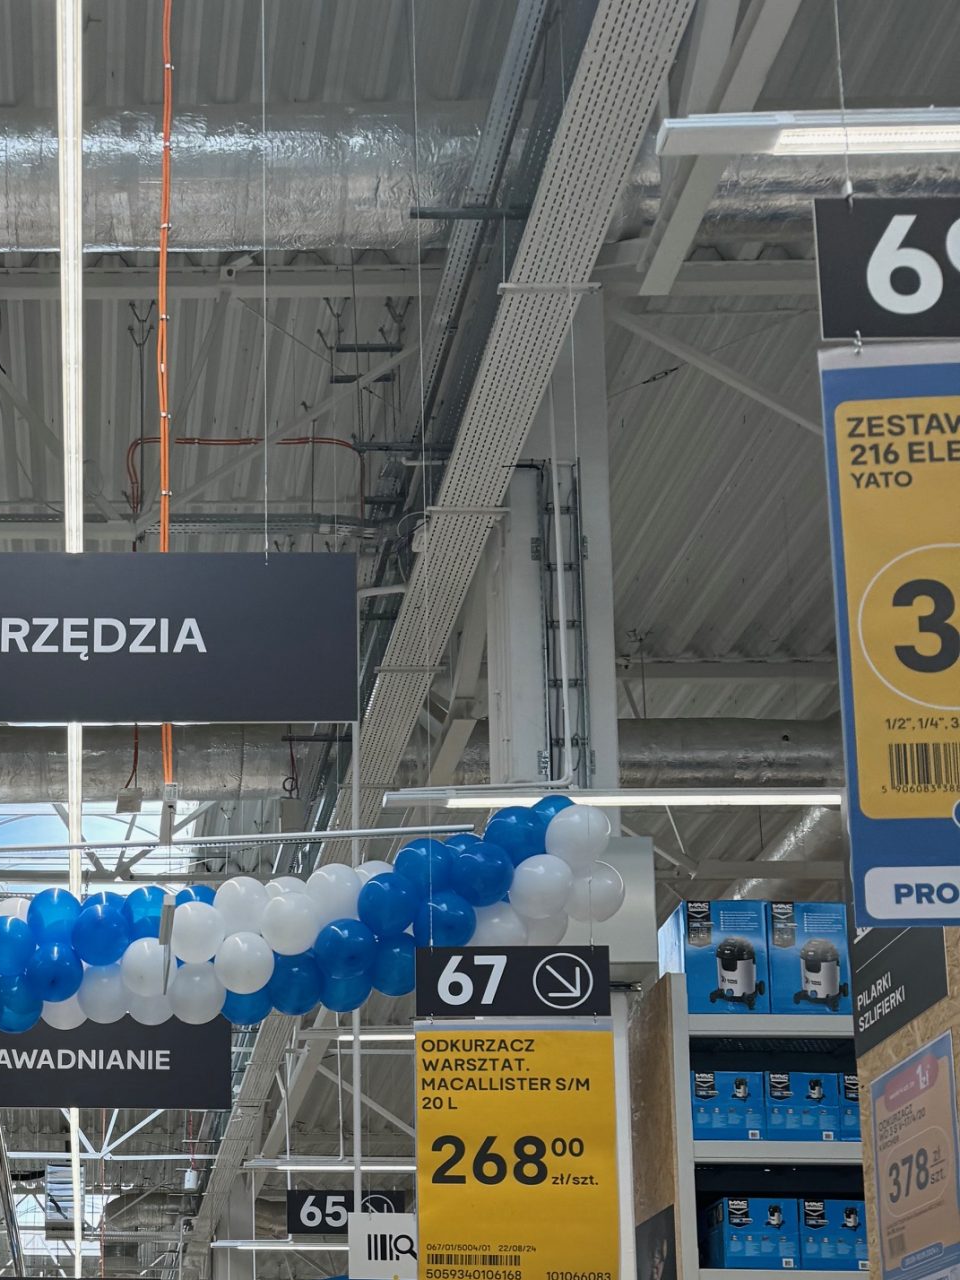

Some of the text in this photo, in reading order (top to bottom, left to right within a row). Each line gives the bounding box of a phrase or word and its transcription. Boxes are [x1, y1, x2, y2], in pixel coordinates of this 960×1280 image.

[866, 214, 960, 315] 6
[850, 443, 900, 466] 216
[850, 471, 913, 489] YATO
[895, 883, 960, 904] PRO
[437, 955, 508, 1005] 67
[857, 970, 892, 1011] PILARKI
[858, 984, 905, 1032] SZLIFIERKI
[421, 1039, 535, 1053] ODKURZACZ
[422, 1058, 530, 1072] WARSZTAT.
[421, 1078, 590, 1092] MACALLISTER S/M
[422, 1097, 458, 1110] 20 L
[431, 1135, 599, 1186] 268 00 zł/szt.
[889, 1148, 928, 1203] 378
[300, 1196, 348, 1227] 65
[426, 1269, 522, 1280] 5059340106168
